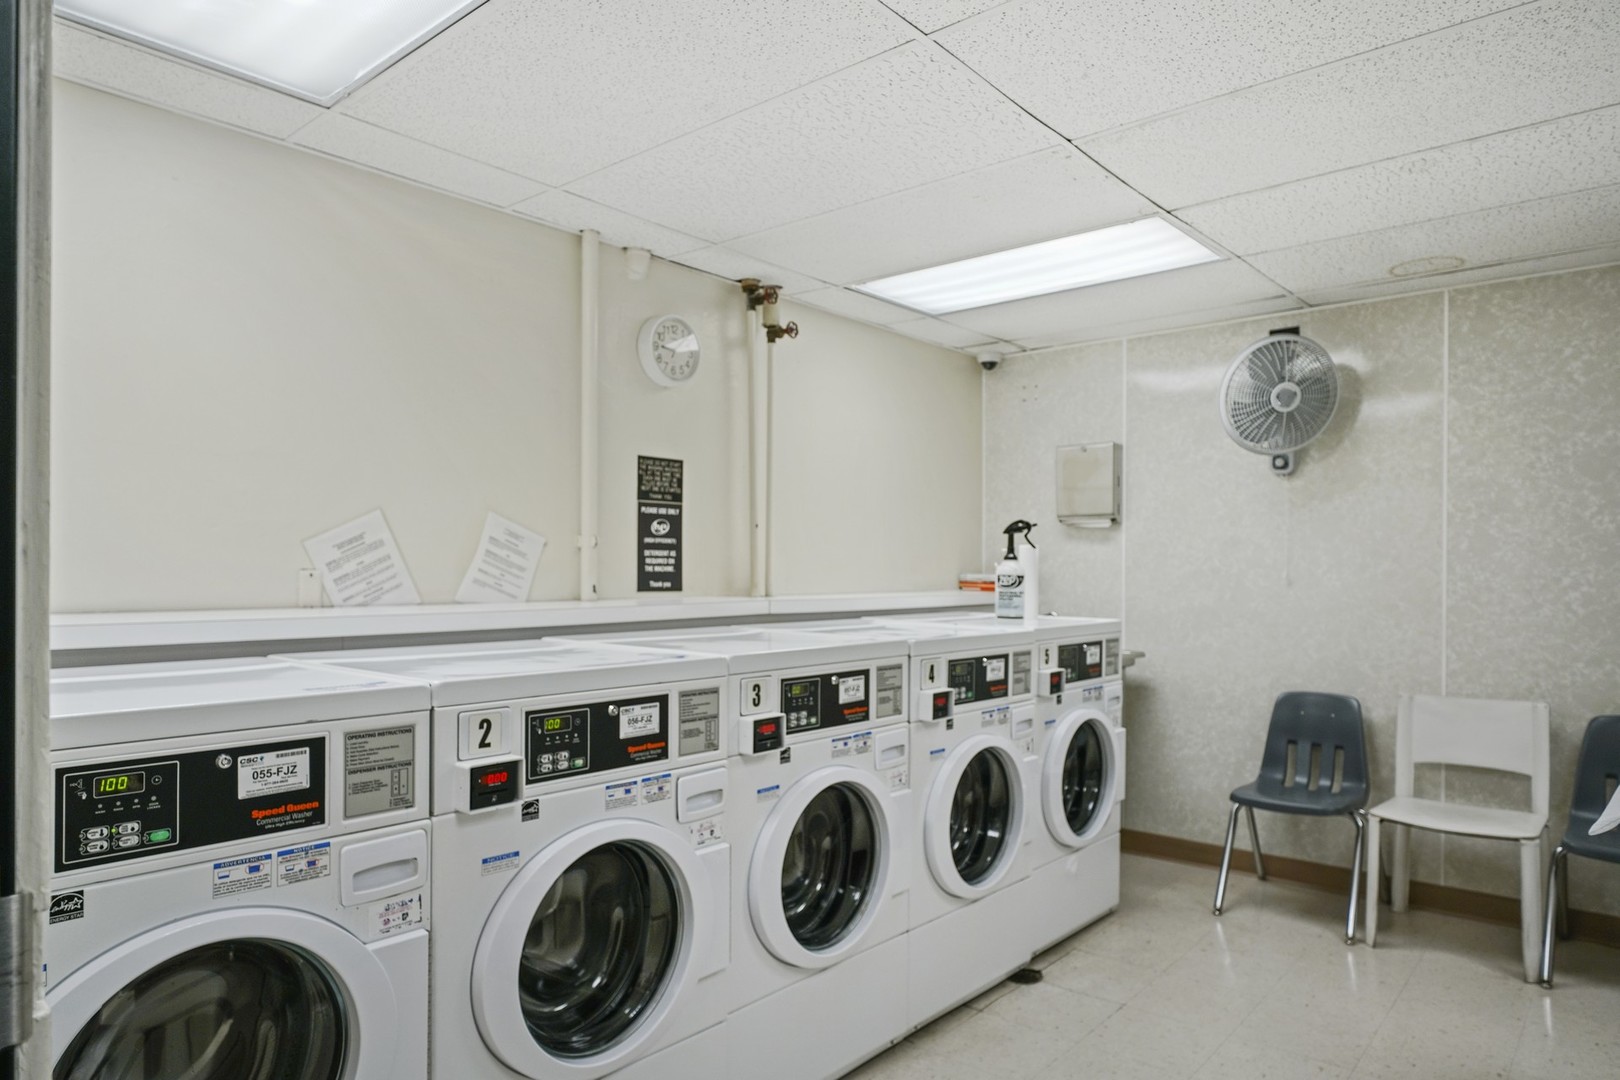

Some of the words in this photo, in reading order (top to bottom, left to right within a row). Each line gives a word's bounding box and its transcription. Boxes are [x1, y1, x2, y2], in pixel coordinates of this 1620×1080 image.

[671, 324, 679, 336] 12
[640, 506, 658, 514] PLEASE
[1045, 648, 1050, 664] 5
[928, 664, 934, 683] 4
[752, 683, 760, 707] 3
[348, 732, 376, 741] OPERATING
[377, 728, 412, 737] INSTRUCTIONS
[478, 718, 492, 748] 2
[240, 756, 258, 765] CSC
[252, 764, 298, 780] 055-FJZ
[348, 767, 376, 776] DISPENSER
[377, 762, 412, 771] INSTRUCTIONS
[100, 776, 128, 792] 100
[252, 805, 285, 818] Speed
[287, 801, 319, 812] Queen
[256, 814, 290, 826] Commercial
[292, 810, 313, 820] Washer
[294, 845, 314, 854] NOTICE
[220, 855, 266, 868] ADVERTENCIA
[50, 914, 70, 923] ENERGY
